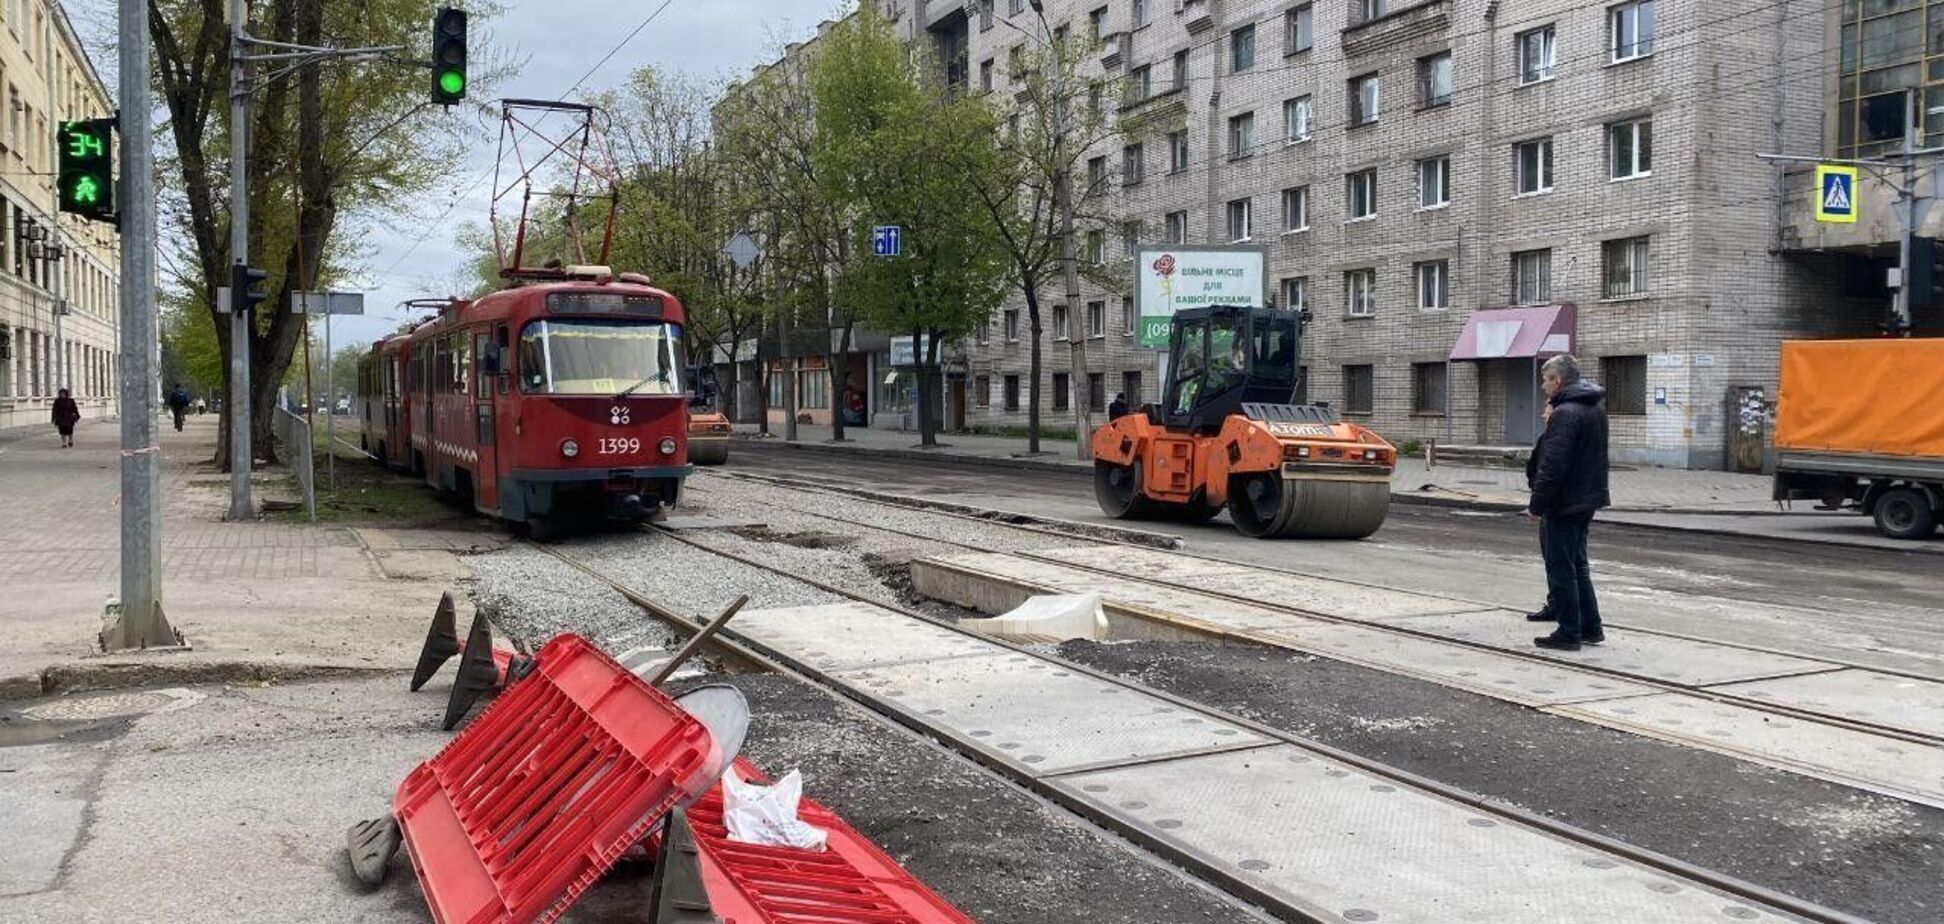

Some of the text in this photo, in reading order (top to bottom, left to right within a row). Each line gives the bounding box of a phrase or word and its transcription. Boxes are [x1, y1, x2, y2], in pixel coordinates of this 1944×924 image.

[69, 133, 102, 156] 34
[1215, 268, 1244, 277] МІСЦЕ
[1203, 282, 1222, 291] ДЛЯ
[1208, 296, 1252, 304] РЕКЛАМИ
[1147, 323, 1175, 338] (09
[599, 438, 640, 453] 1399
